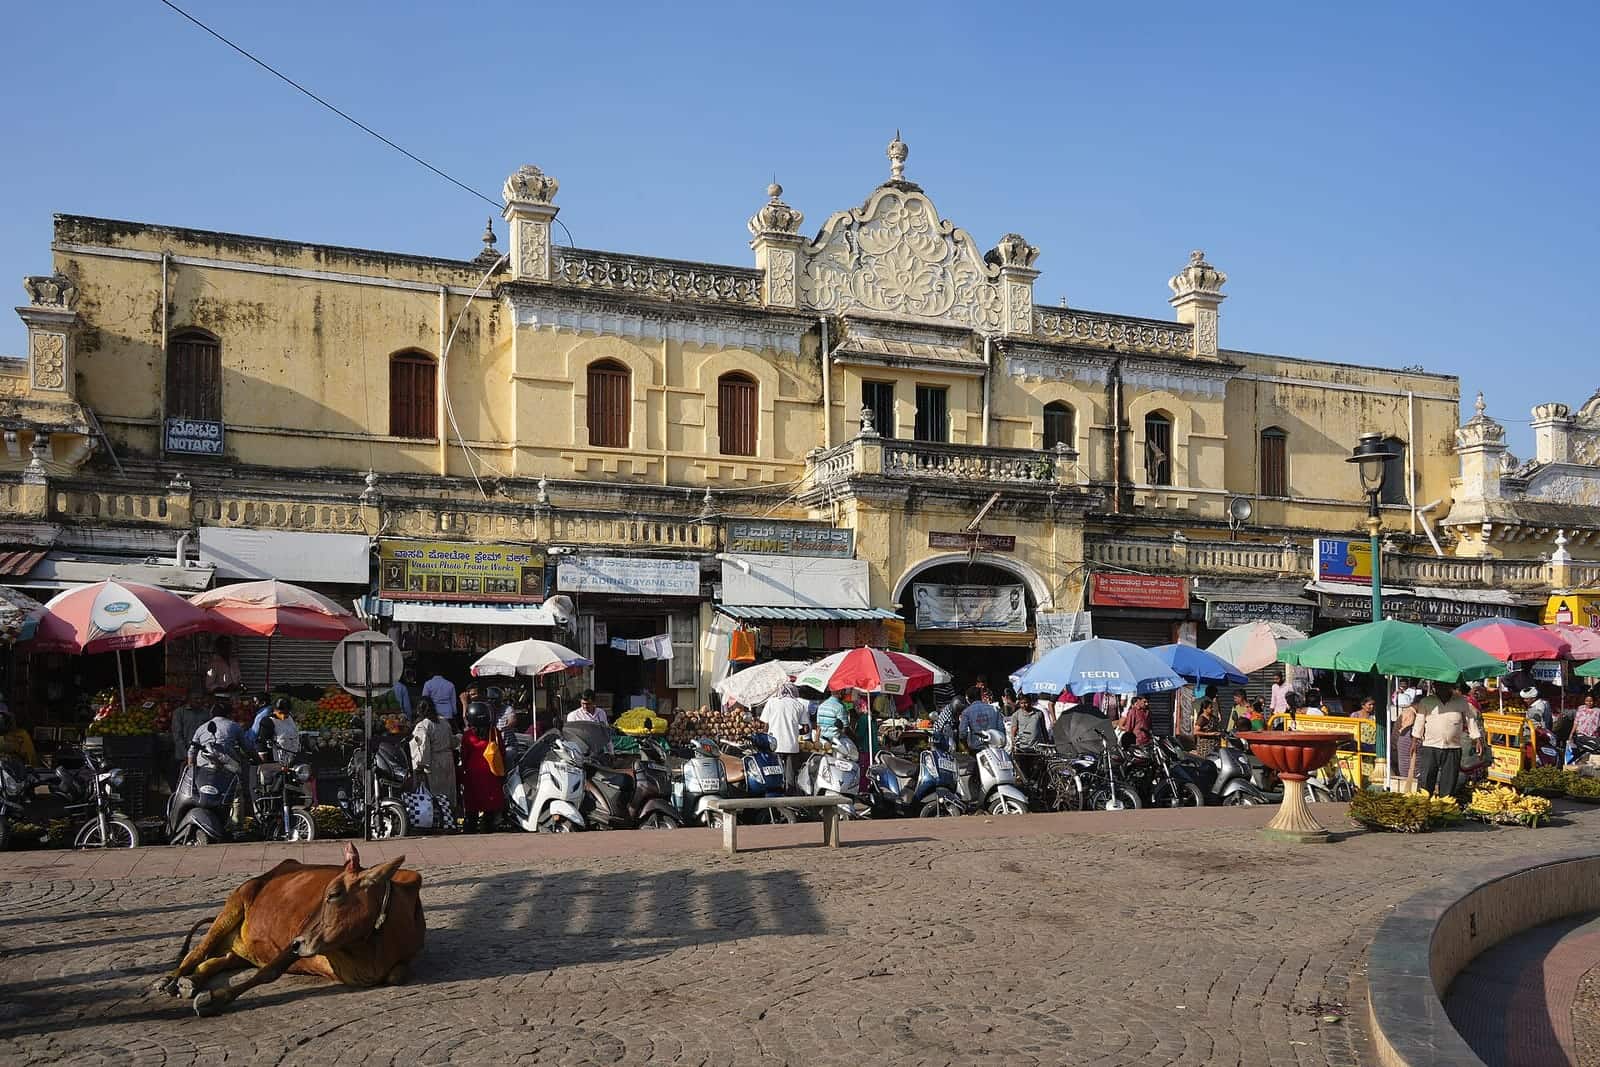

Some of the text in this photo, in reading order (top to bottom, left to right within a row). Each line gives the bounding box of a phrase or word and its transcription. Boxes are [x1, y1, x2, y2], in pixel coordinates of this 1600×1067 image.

[169, 437, 221, 452] NOTARY
[732, 538, 788, 552] PRIME
[1321, 541, 1339, 555] DH
[491, 564, 515, 572] Works
[1413, 600, 1511, 617] GOWRISHANKAR
[1080, 671, 1120, 679] TECNO
